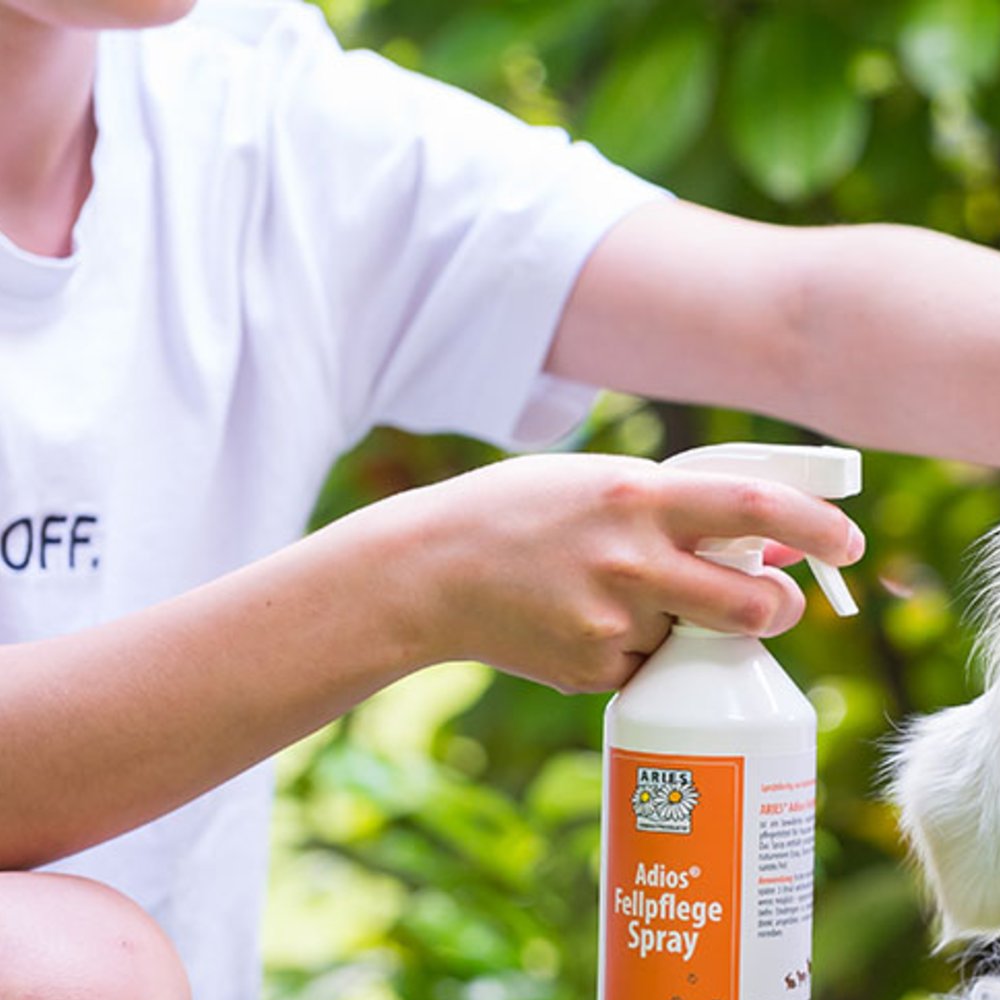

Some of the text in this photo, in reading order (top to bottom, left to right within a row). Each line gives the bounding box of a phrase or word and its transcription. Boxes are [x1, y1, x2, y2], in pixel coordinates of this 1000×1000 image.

[1, 515, 99, 571] OFF.
[640, 769, 688, 786] ARIES
[614, 887, 724, 929] Fellpflege
[628, 920, 700, 962] Spray
